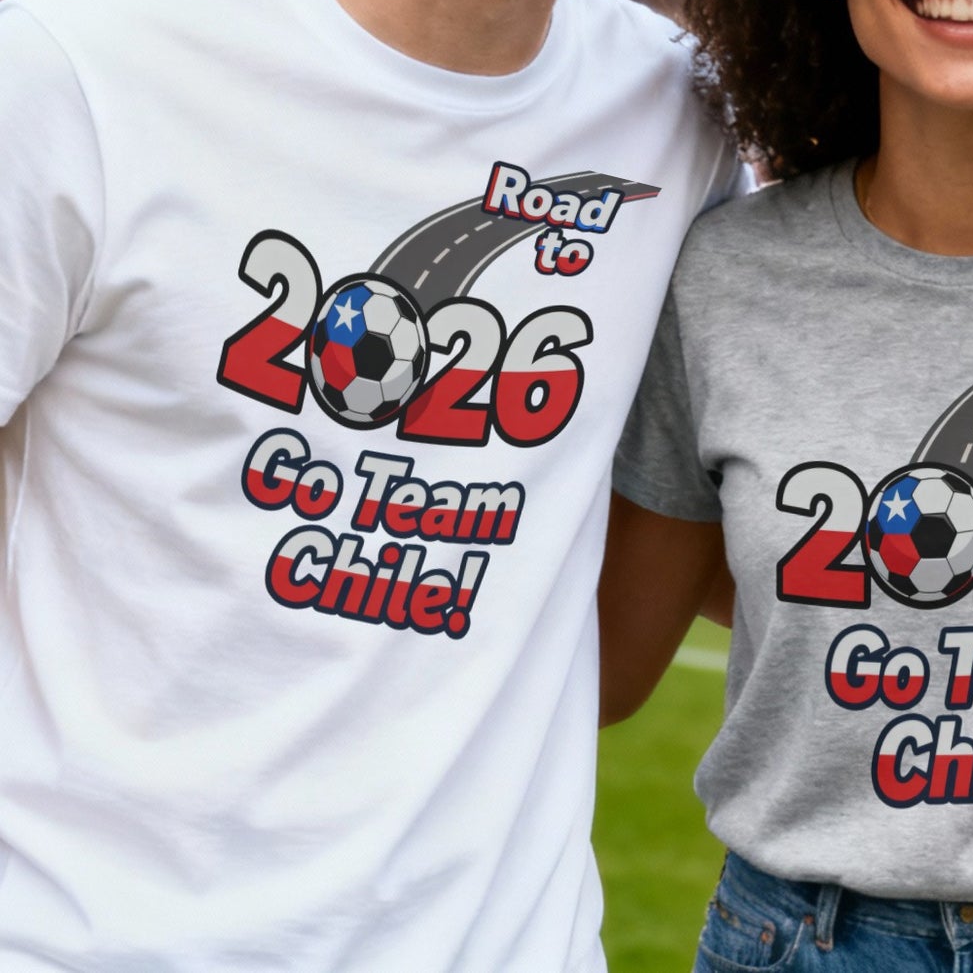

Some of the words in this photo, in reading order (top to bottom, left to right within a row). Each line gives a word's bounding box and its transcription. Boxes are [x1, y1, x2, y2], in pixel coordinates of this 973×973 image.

[482, 161, 625, 234] Road
[535, 229, 593, 276] to
[216, 229, 593, 448] 2026
[241, 427, 344, 521] Go
[351, 450, 526, 545] Team
[265, 524, 489, 640] Chile!
[825, 623, 930, 710] Go
